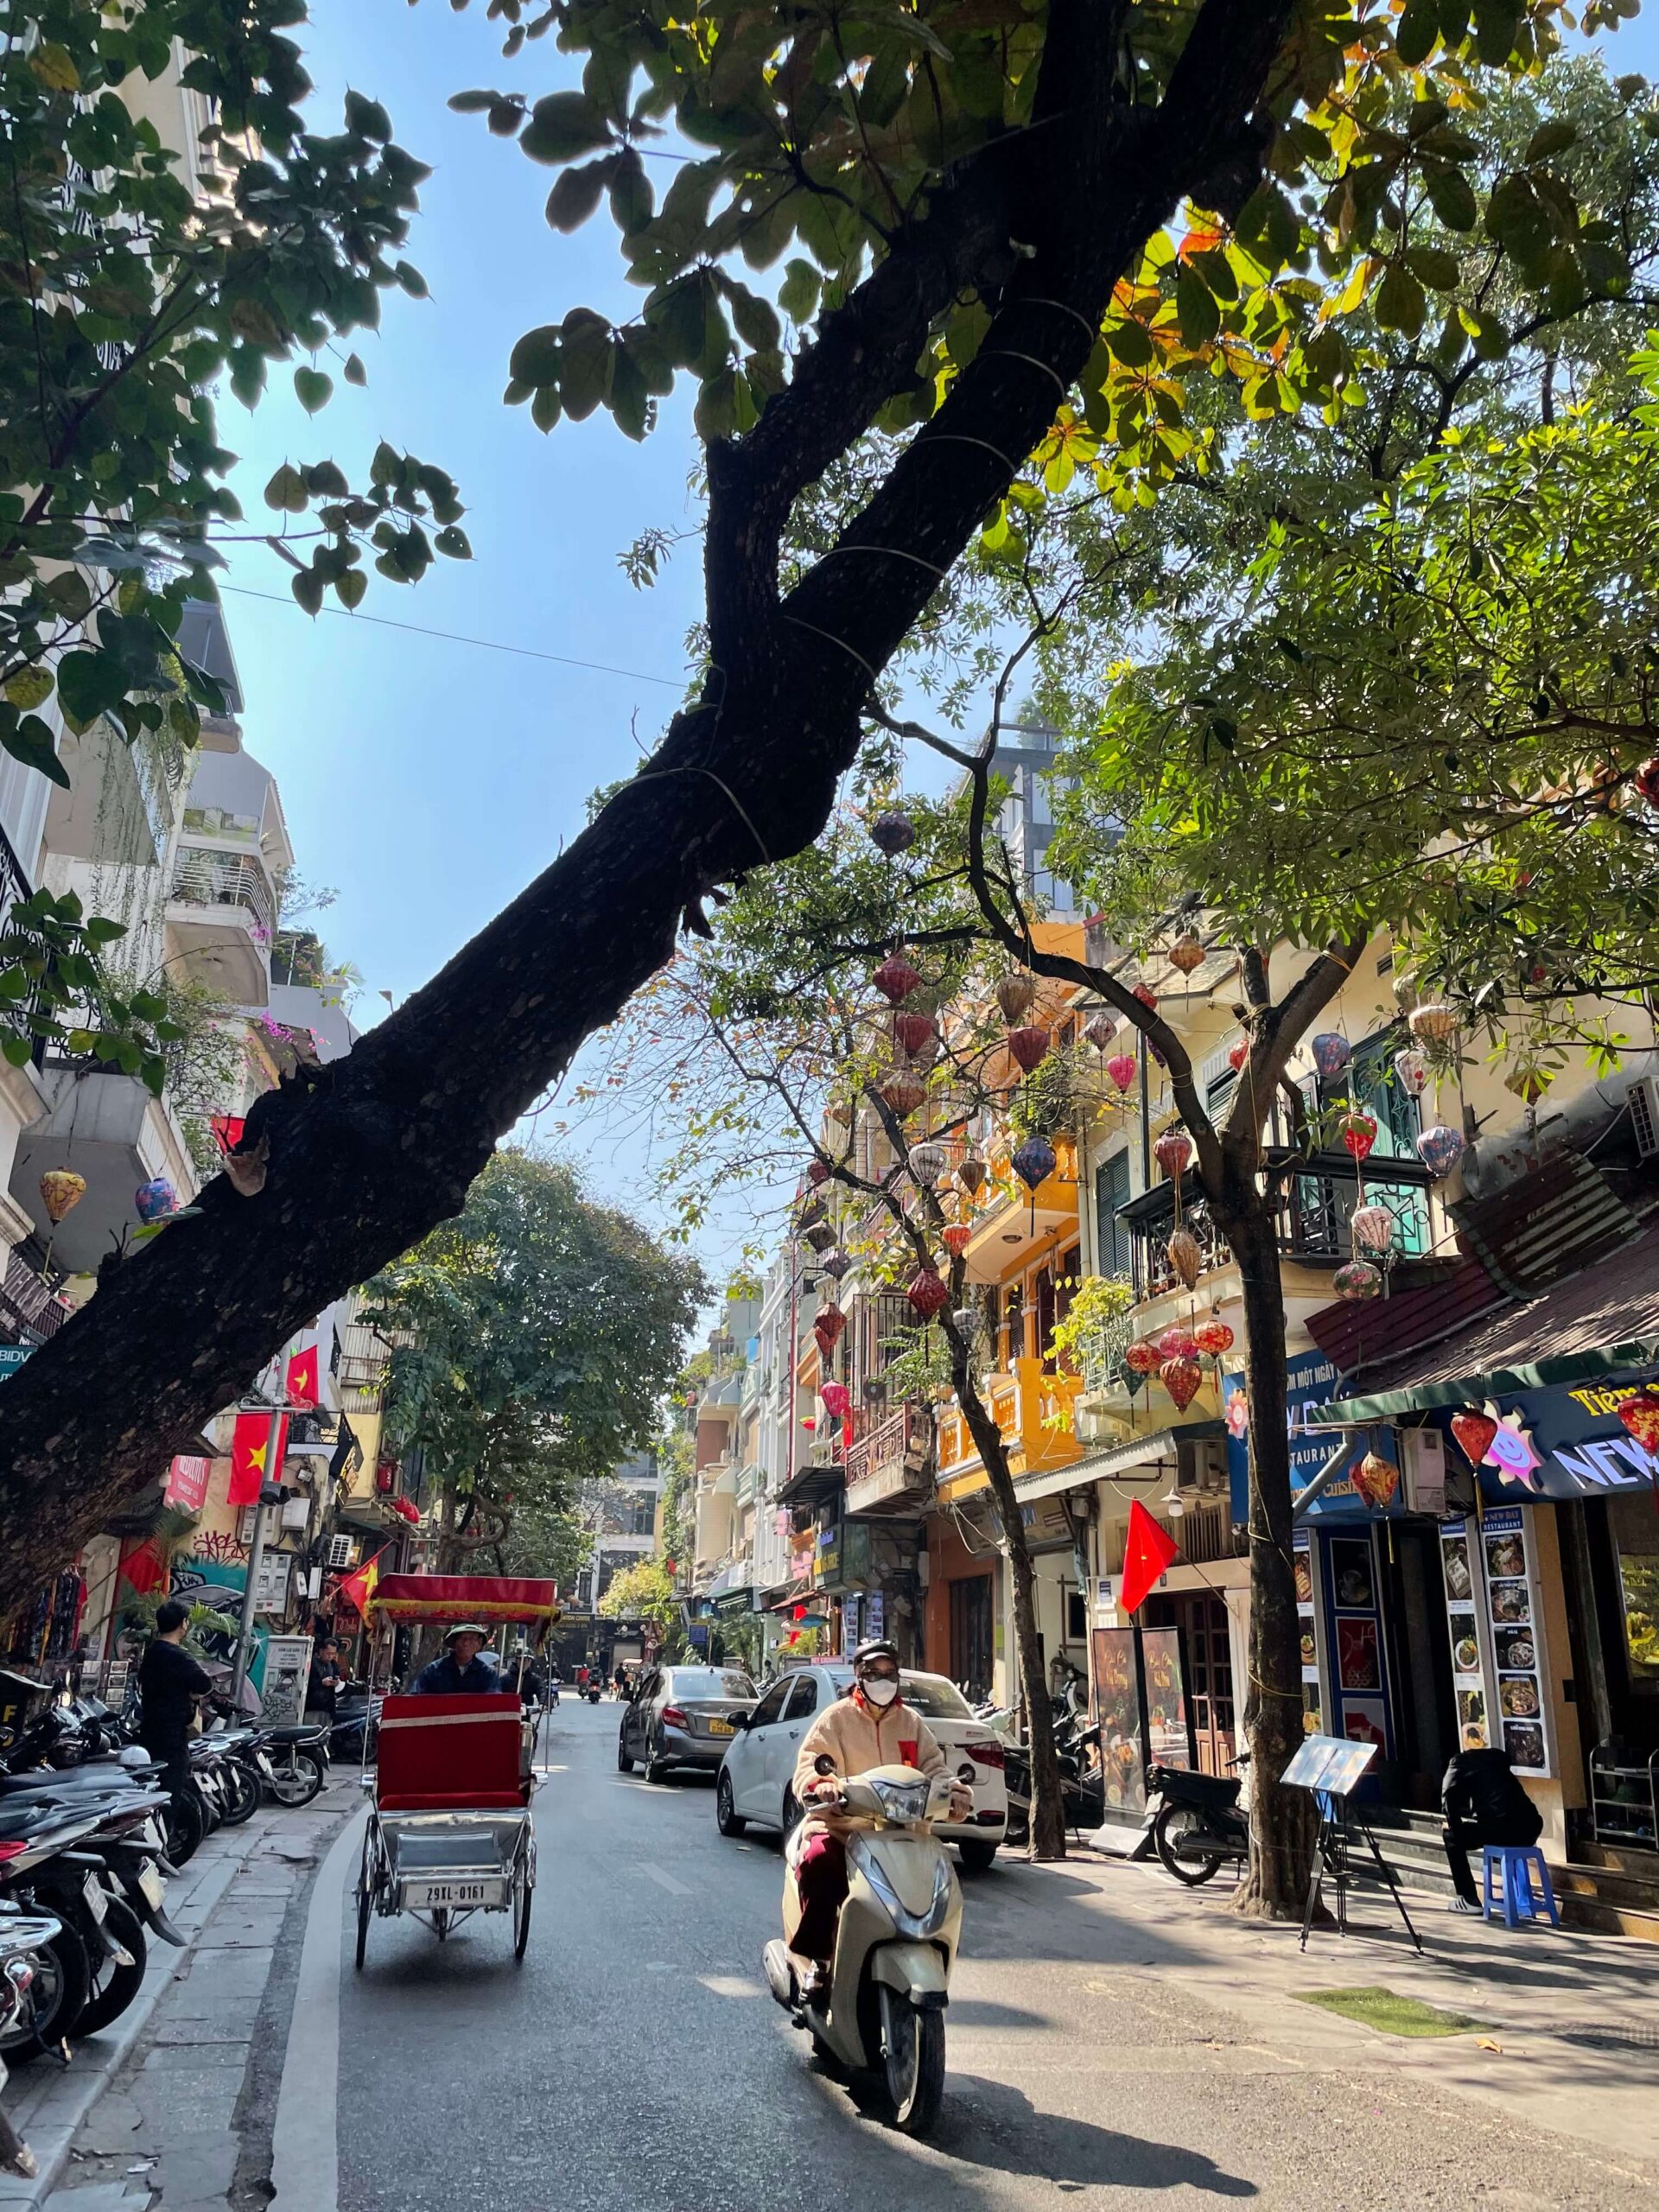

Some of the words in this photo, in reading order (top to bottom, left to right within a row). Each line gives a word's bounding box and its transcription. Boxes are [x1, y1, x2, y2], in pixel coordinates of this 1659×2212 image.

[0, 1350, 32, 1363] BIDV
[1297, 1367, 1313, 1389] MỘT
[1314, 1360, 1335, 1384] NGÀY
[1484, 1521, 1521, 1530] RESTAURANT
